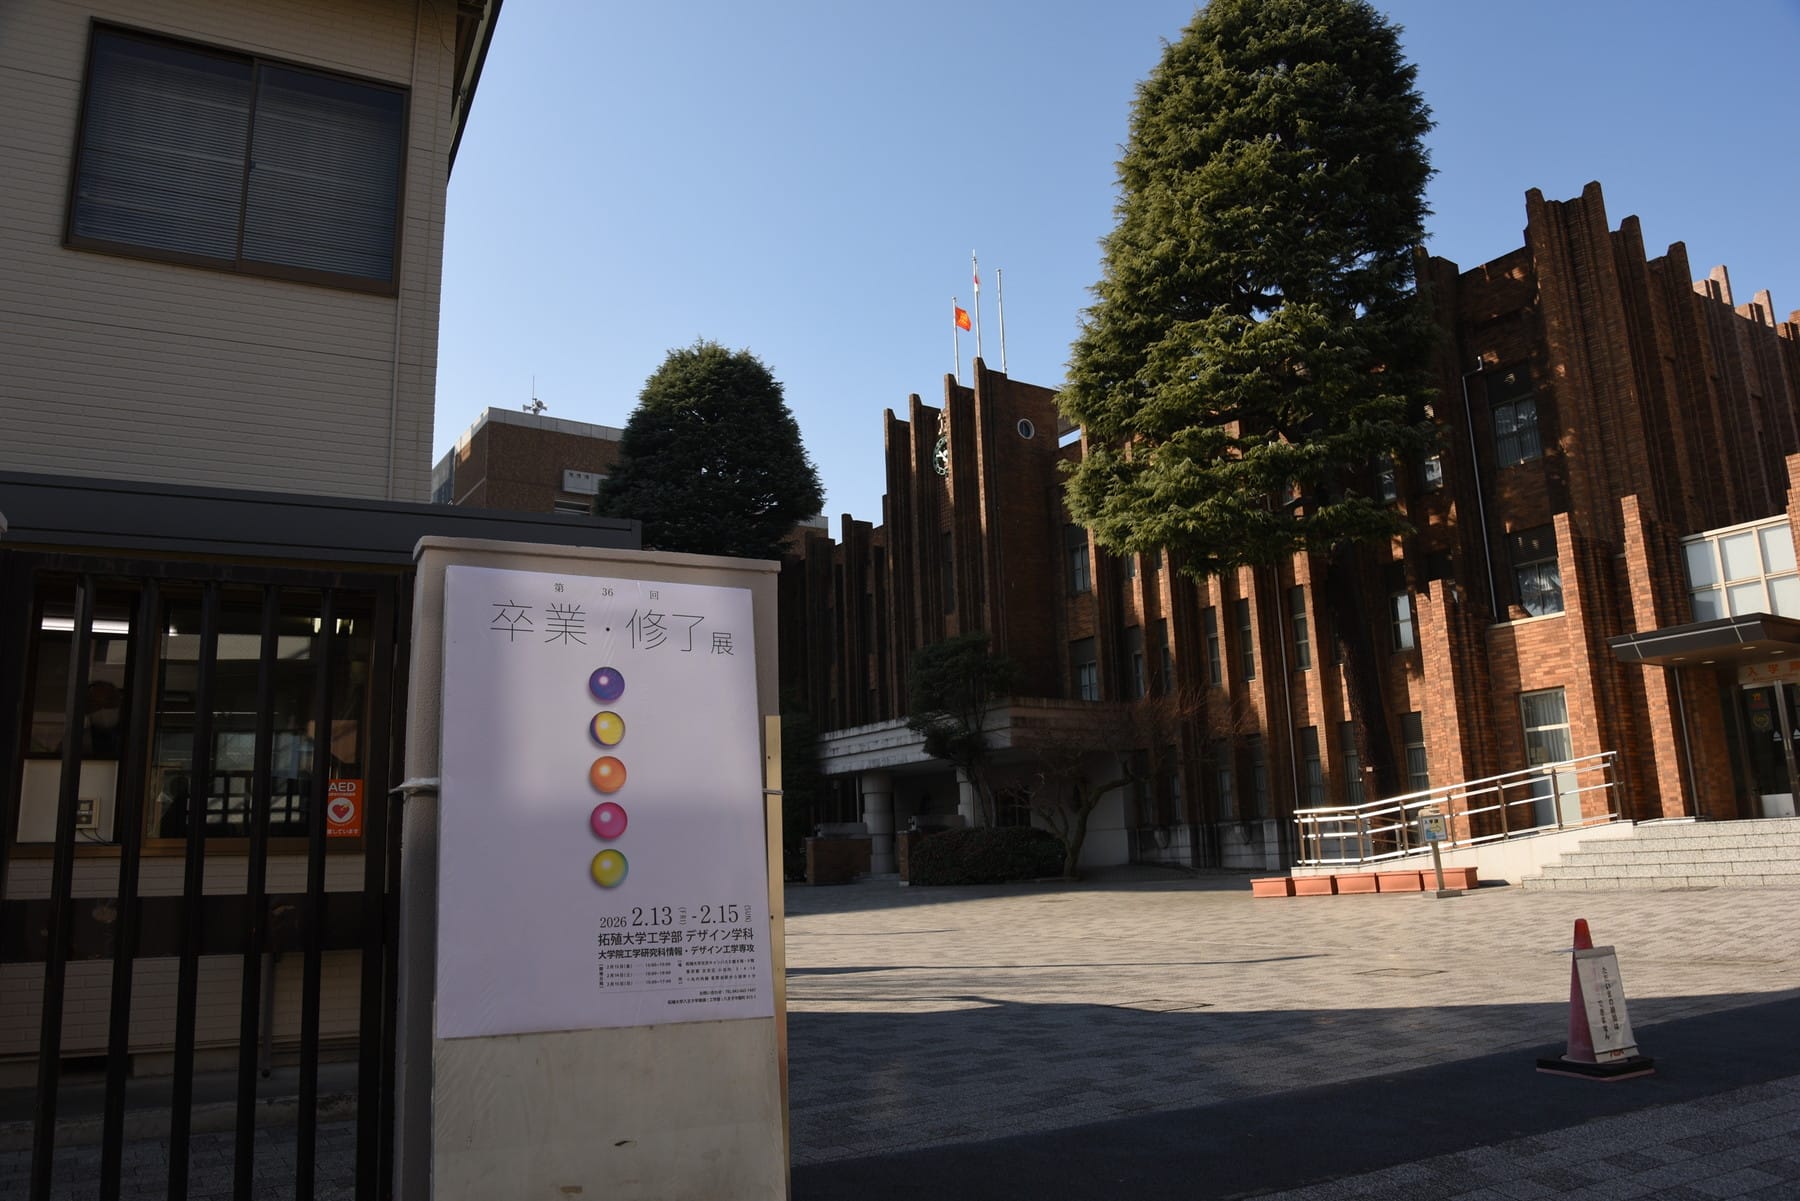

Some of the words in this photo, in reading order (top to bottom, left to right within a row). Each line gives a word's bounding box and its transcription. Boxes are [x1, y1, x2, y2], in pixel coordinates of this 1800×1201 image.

[554, 583, 564, 593] 第
[602, 587, 614, 597] 36
[650, 591, 659, 600] 回
[328, 782, 355, 791] AED
[599, 916, 627, 928] 2026
[632, 906, 673, 926] 2.13
[700, 904, 739, 924] 2.15
[598, 930, 683, 947] 拓殖大学工学部
[686, 928, 754, 942] デザイン学科
